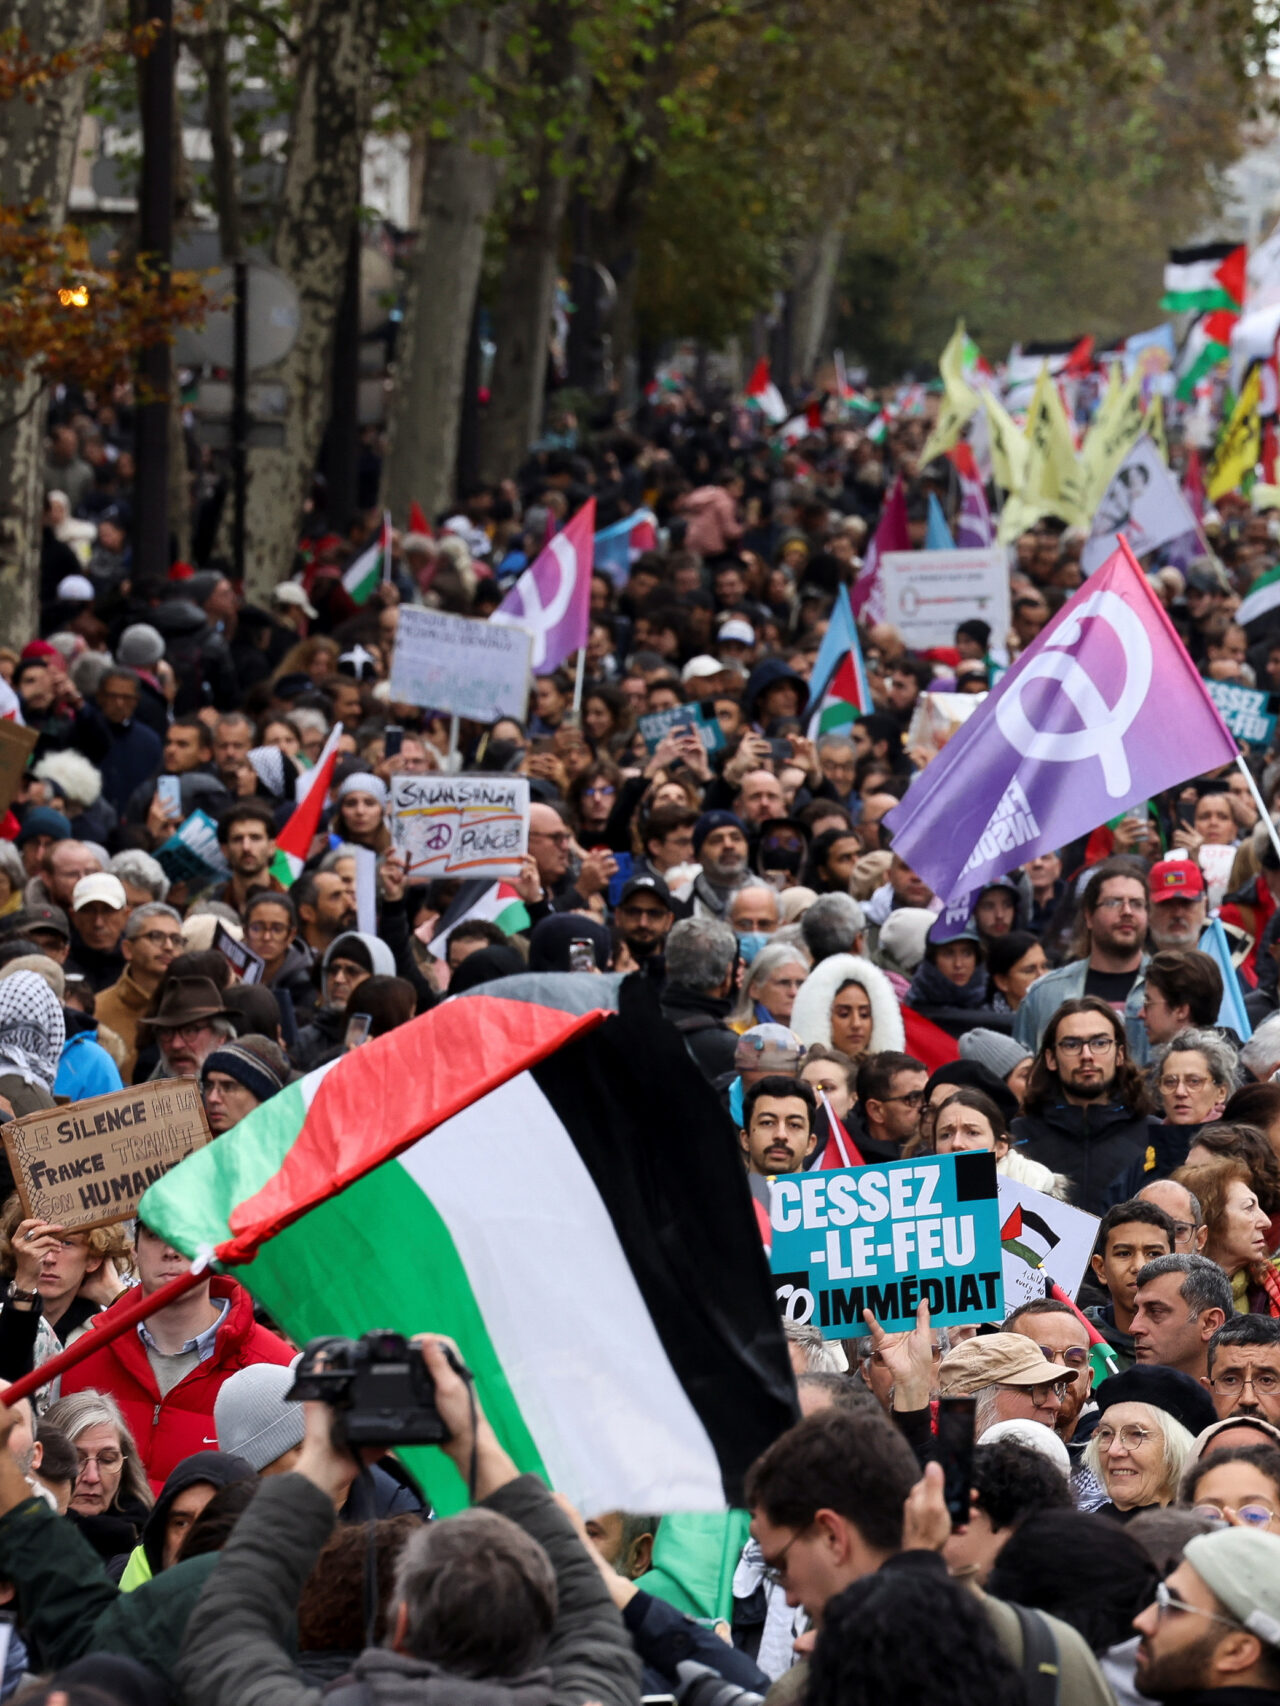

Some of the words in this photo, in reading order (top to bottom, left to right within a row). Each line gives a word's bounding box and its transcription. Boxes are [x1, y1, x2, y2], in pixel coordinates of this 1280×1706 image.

[1205, 682, 1265, 715] ESSEZ
[22, 1125, 53, 1152] LE
[56, 1101, 147, 1144] SILENCE
[152, 1095, 173, 1118] DE
[175, 1089, 198, 1113] LA
[28, 1153, 106, 1190] FRANCE
[111, 1121, 194, 1166] TRAHIT
[38, 1191, 75, 1219] SON
[78, 1148, 194, 1210] HUMANI
[770, 1164, 943, 1233] CESSEZ
[810, 1214, 977, 1281] -LE-FEU
[819, 1272, 1001, 1328] IMMÉDIAT
